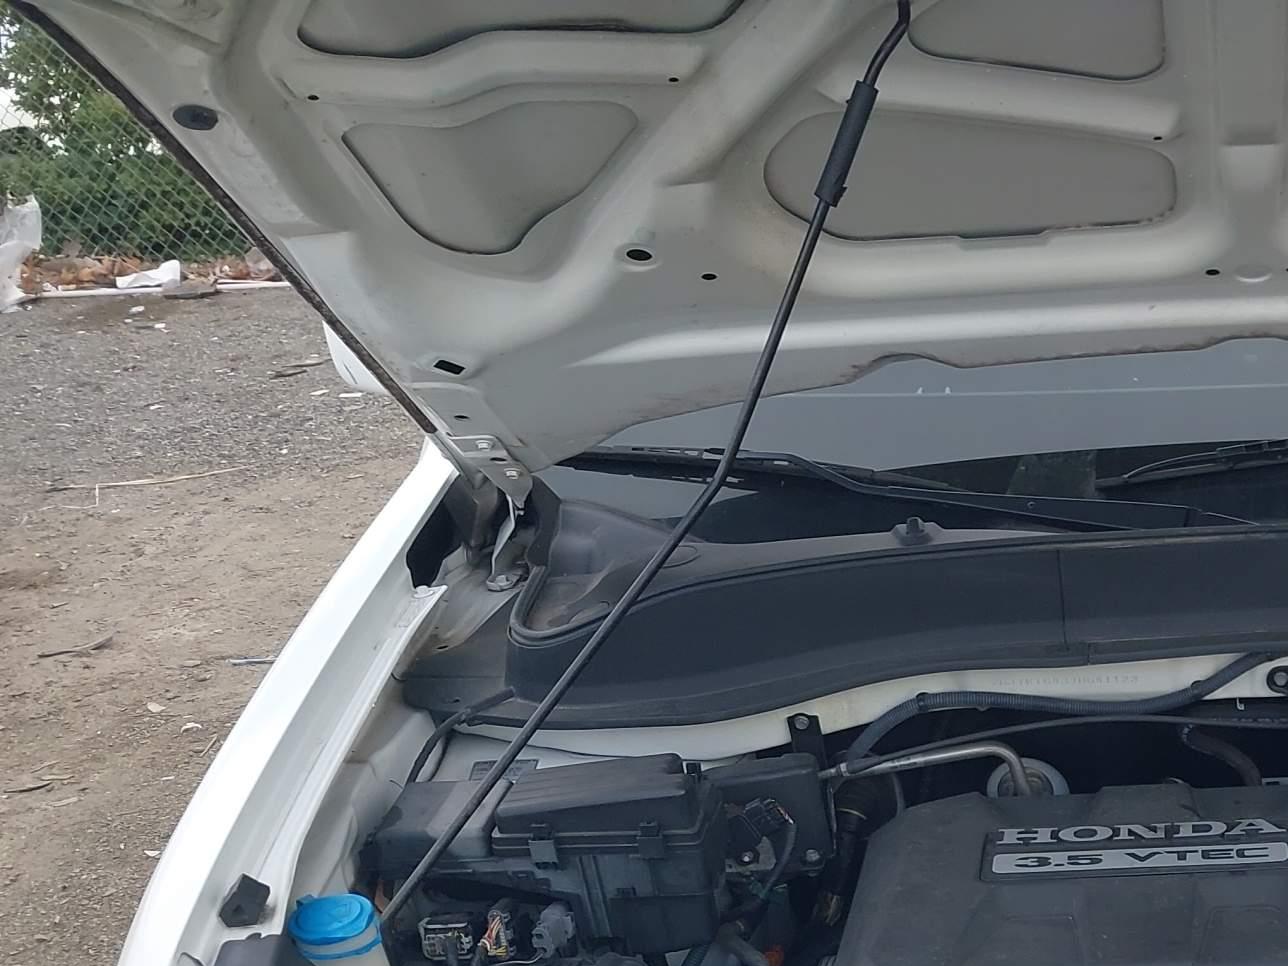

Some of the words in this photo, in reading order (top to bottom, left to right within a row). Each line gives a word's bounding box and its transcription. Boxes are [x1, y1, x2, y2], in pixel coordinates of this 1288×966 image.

[996, 818, 1288, 844] HONDA
[1013, 855, 1104, 868] 3.5
[1124, 847, 1270, 863] VTEC
